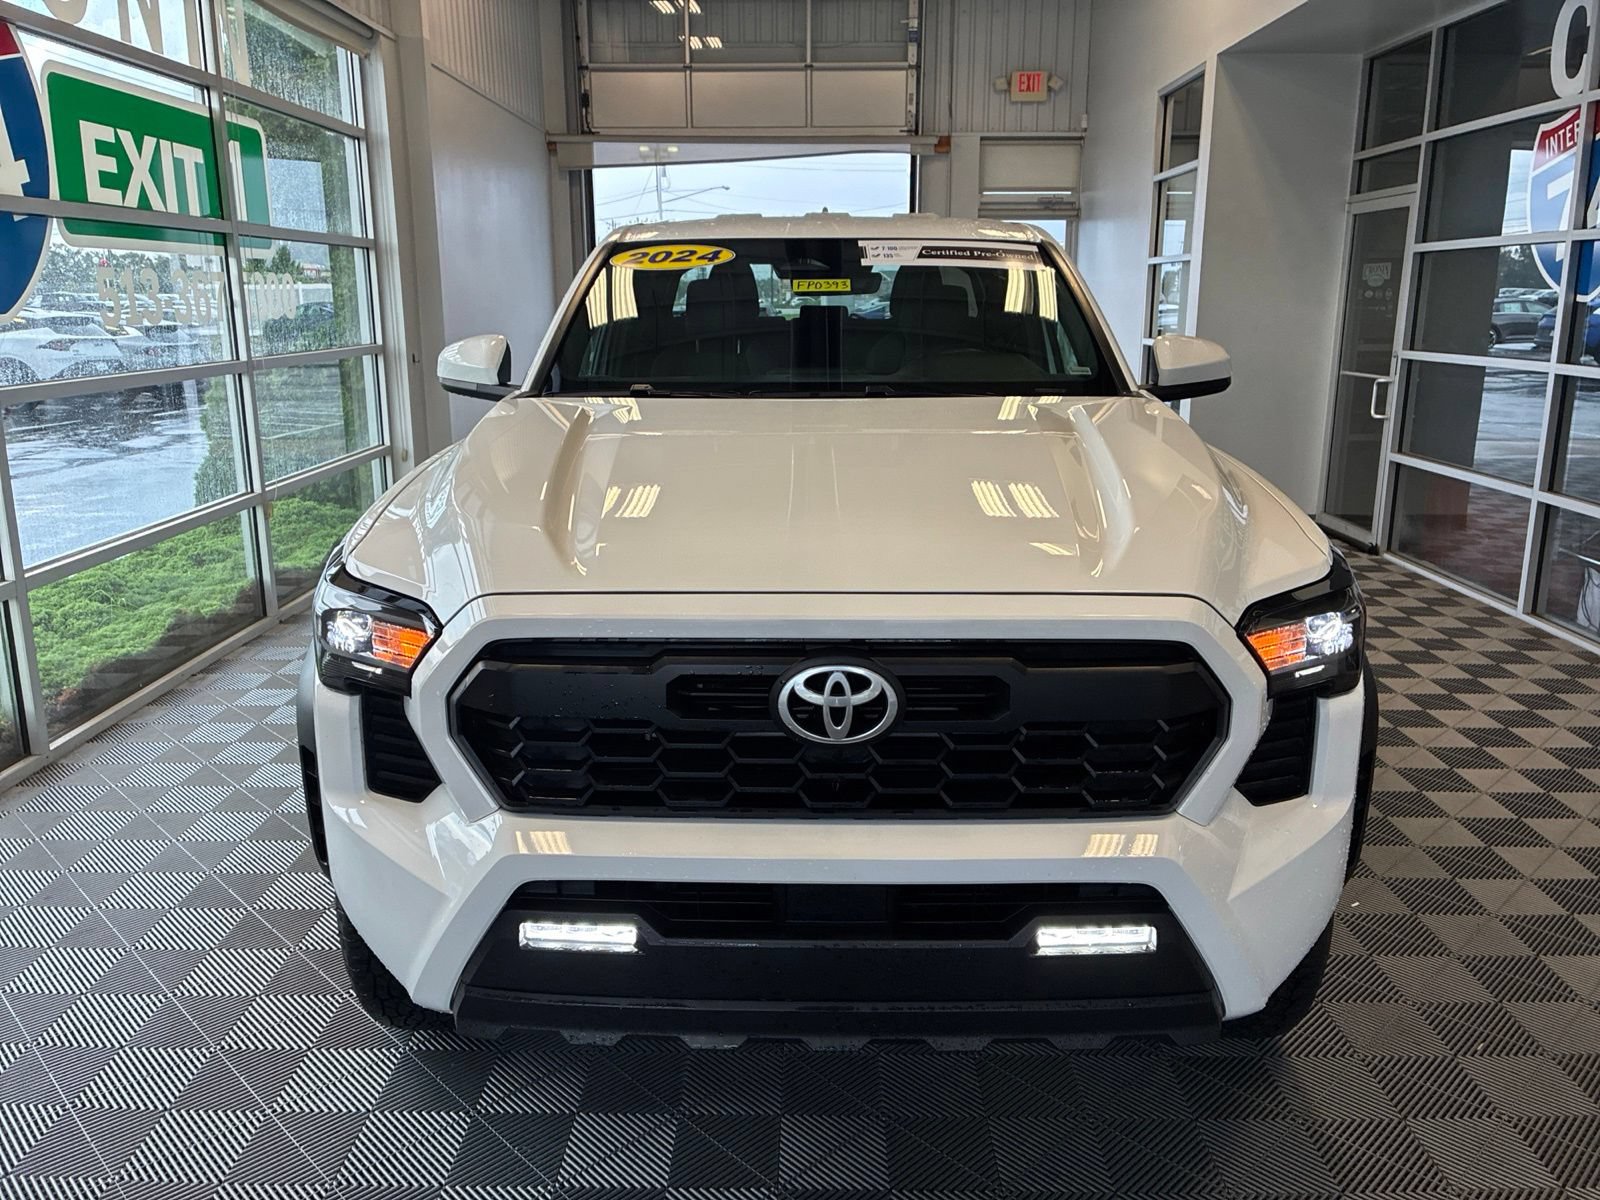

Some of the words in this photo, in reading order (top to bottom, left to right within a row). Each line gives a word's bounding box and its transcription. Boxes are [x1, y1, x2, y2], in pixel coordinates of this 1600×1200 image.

[1018, 73, 1041, 93] EXIT
[79, 119, 204, 218] EXIT
[621, 249, 723, 265] 2024
[922, 248, 971, 256] Certified
[973, 250, 1034, 261] Pre-Owned
